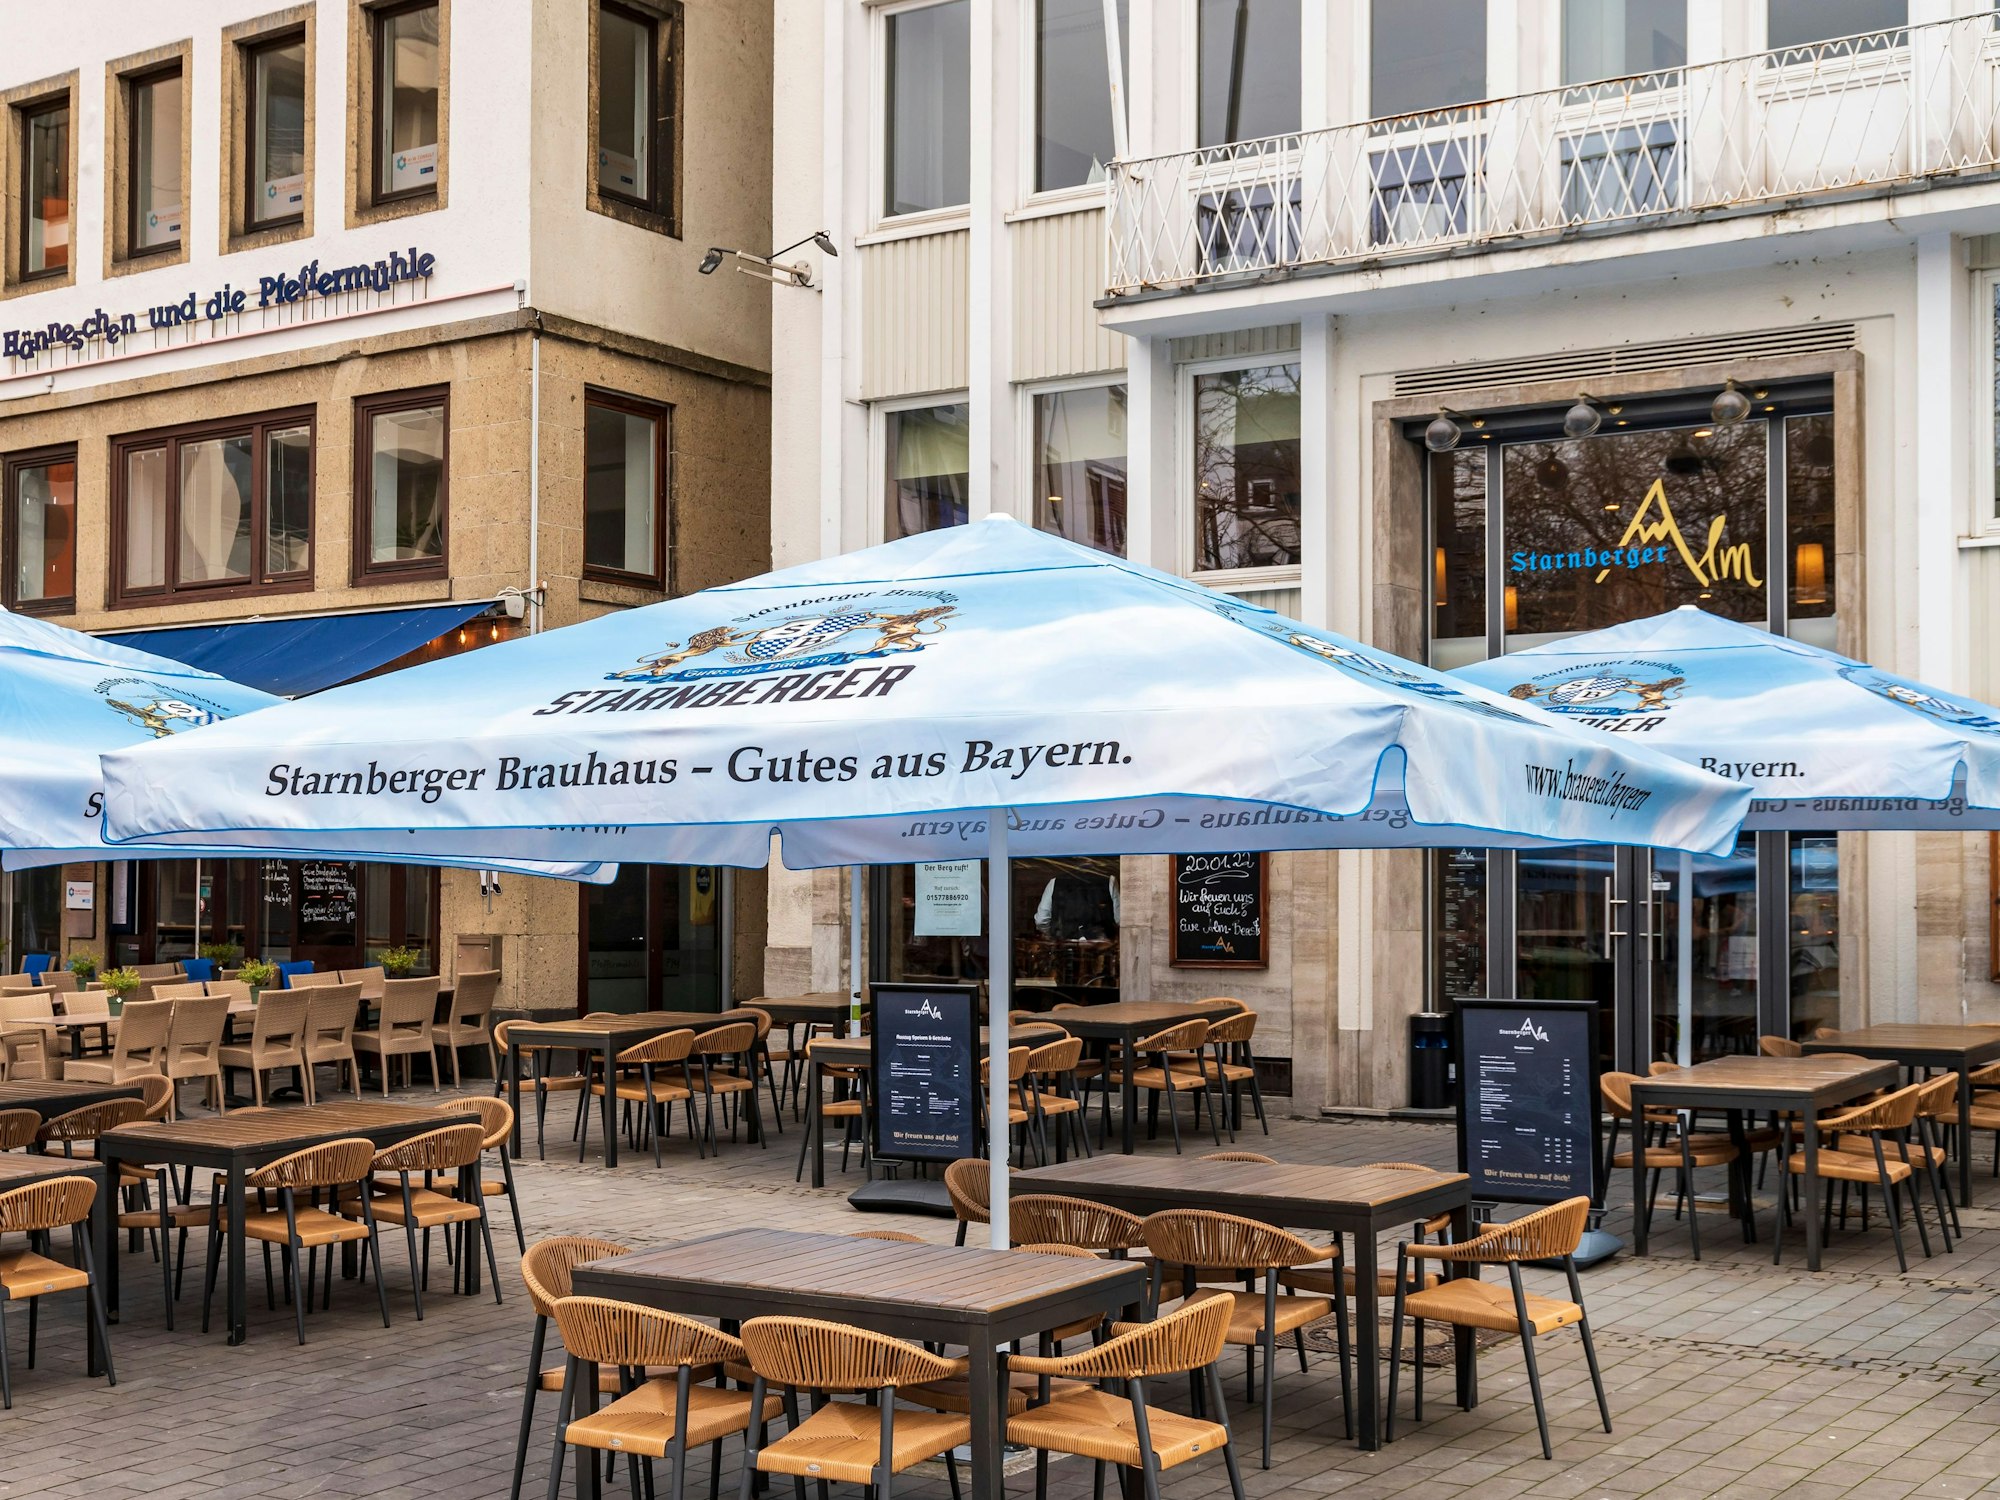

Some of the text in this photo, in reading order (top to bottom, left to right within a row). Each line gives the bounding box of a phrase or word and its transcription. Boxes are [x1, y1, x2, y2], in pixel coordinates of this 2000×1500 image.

[3, 247, 435, 360] Hänneschen und die Pfeffermühle
[1511, 478, 1763, 588] Starnberger Alm
[731, 591, 877, 623] Starnberger
[732, 665, 762, 675] aus
[768, 656, 830, 672] Bayern
[1532, 660, 1625, 681] Starnberger
[533, 664, 917, 716] STARNBERGER
[264, 761, 486, 804] Starnberger
[495, 751, 678, 791] Brauhaus
[727, 745, 858, 783] Gutes
[870, 750, 946, 780] aus
[960, 739, 1133, 780] Bayern.
[1525, 759, 1654, 820] www.brauerei.bayern
[937, 864, 953, 872] Berg
[954, 863, 969, 872] ruft!
[1180, 888, 1254, 904] Wir freuen uns
[1192, 903, 1212, 917] auf
[904, 1131, 923, 1140] freuen
[935, 1134, 945, 1142] auf
[945, 1134, 959, 1142] dich!
[1499, 1170, 1523, 1179] freuen
[1539, 1173, 1553, 1181] auf
[1553, 1173, 1571, 1182] dich!
